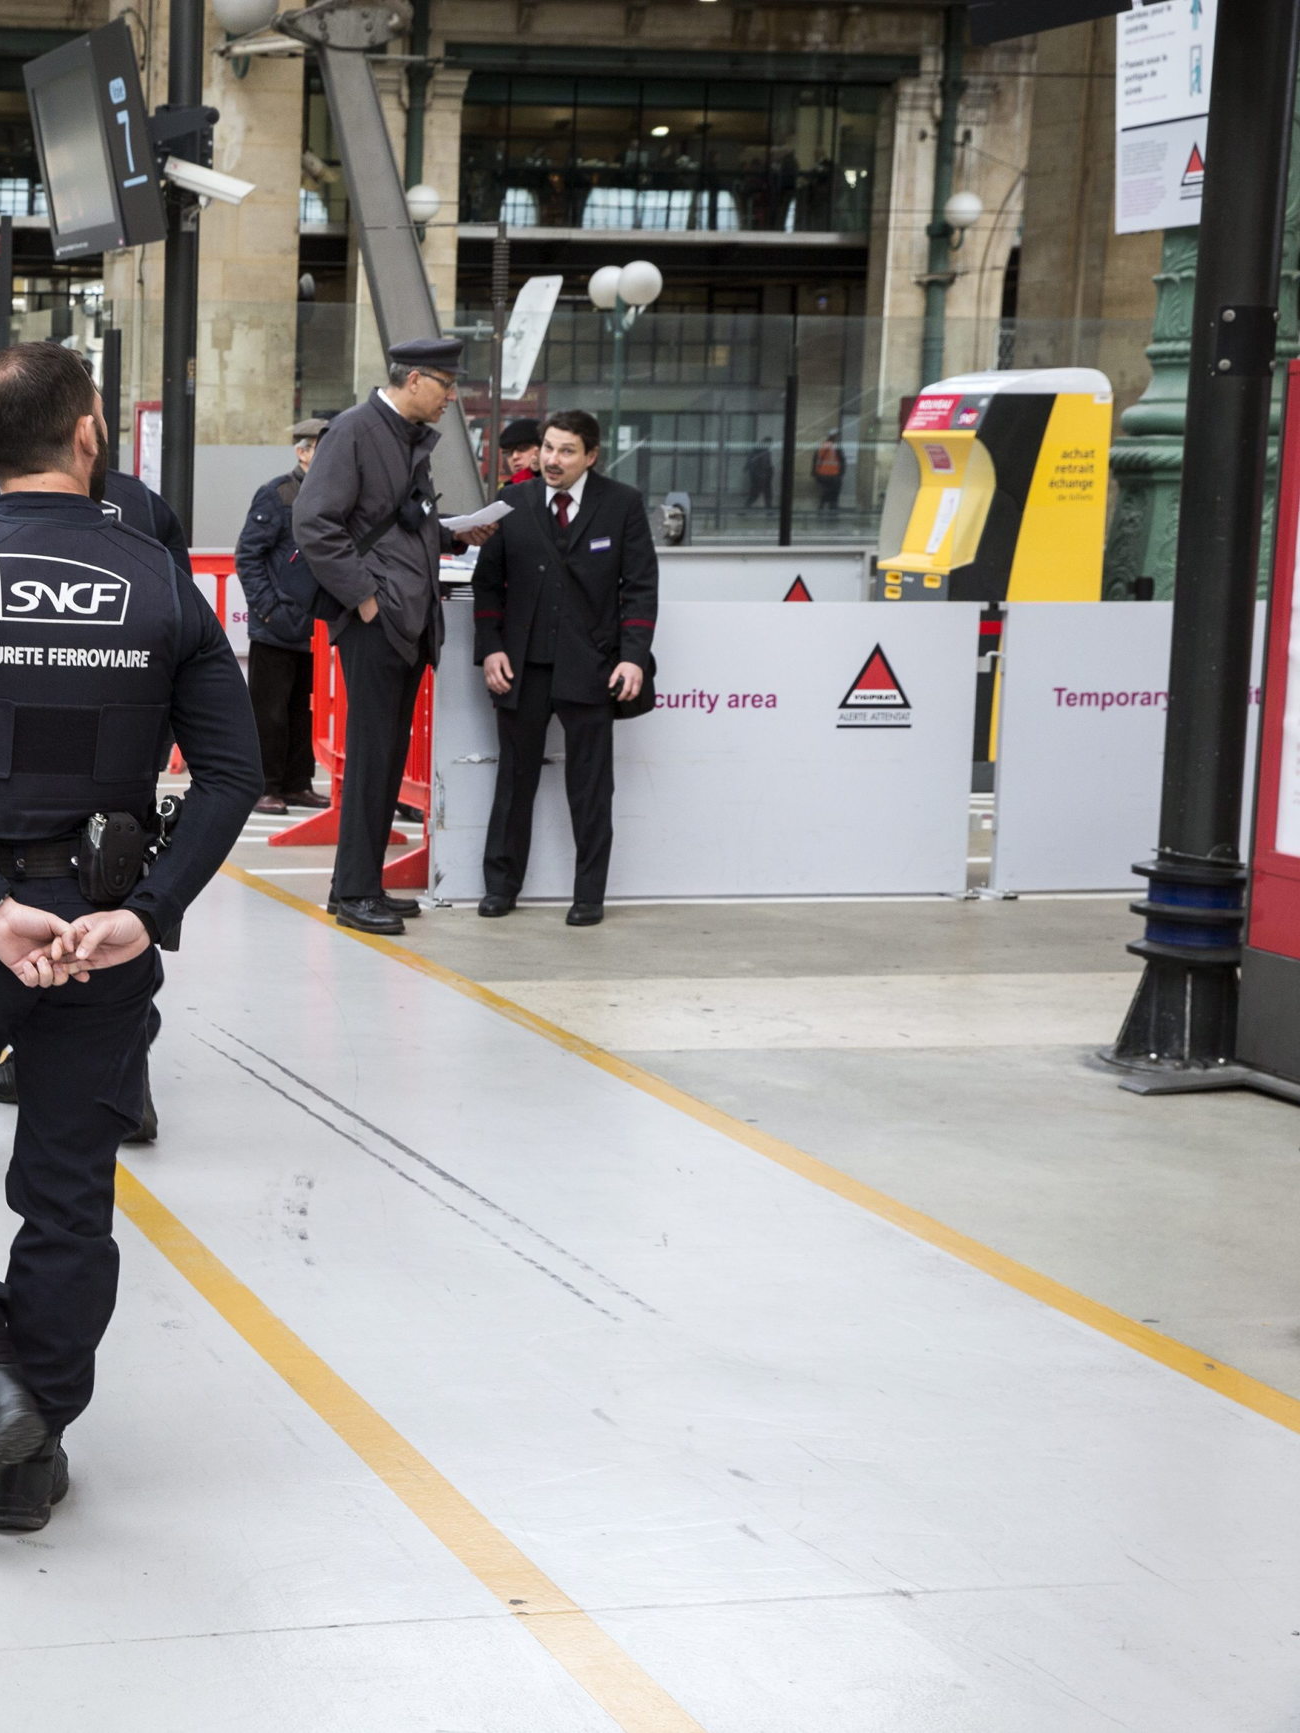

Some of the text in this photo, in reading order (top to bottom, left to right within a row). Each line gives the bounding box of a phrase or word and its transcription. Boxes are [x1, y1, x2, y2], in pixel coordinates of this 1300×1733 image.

[117, 110, 135, 172] 7
[6, 580, 122, 614] SNCF
[48, 647, 150, 668] FERROVIAIRE
[654, 688, 778, 714] curity area
